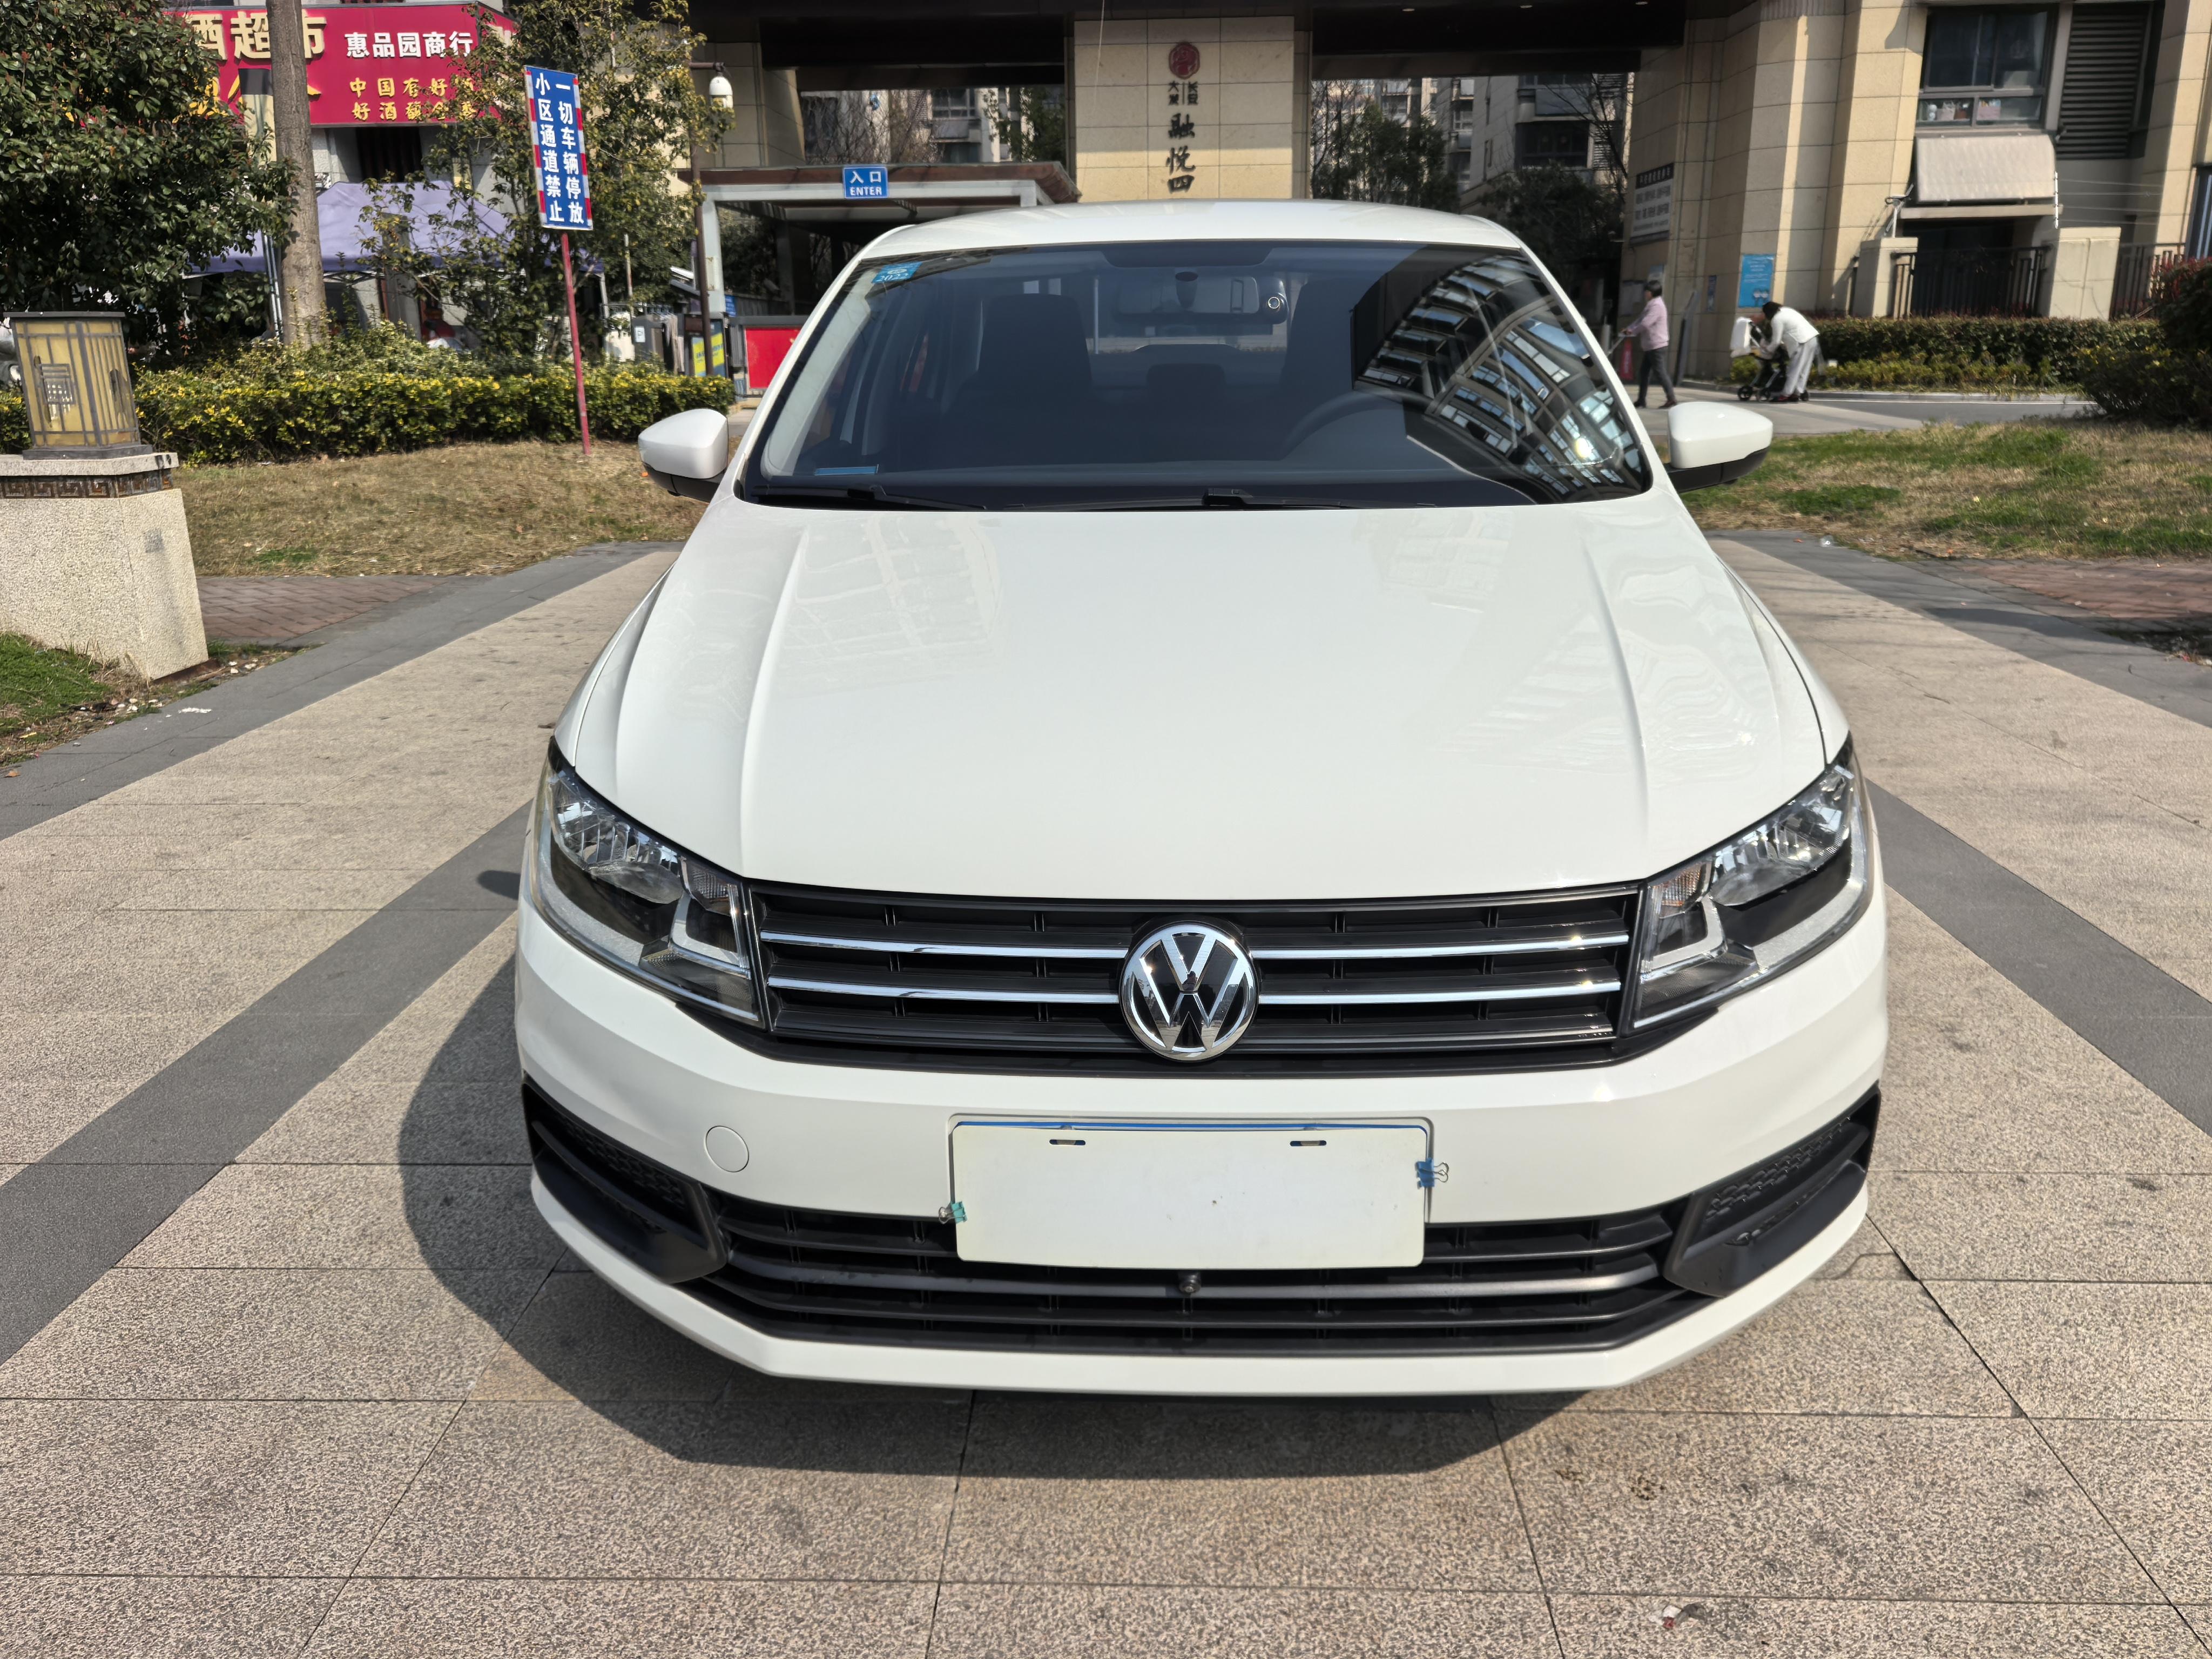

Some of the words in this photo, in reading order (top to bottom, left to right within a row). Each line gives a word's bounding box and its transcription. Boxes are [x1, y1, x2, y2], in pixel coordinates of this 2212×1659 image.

[344, 30, 473, 58] 惠品园商行
[349, 77, 474, 99] 中国有好
[535, 72, 565, 222] 小区通道禁止
[555, 83, 584, 224] 一切车辆停放
[849, 171, 882, 184] 入口
[849, 186, 882, 196] ENTER
